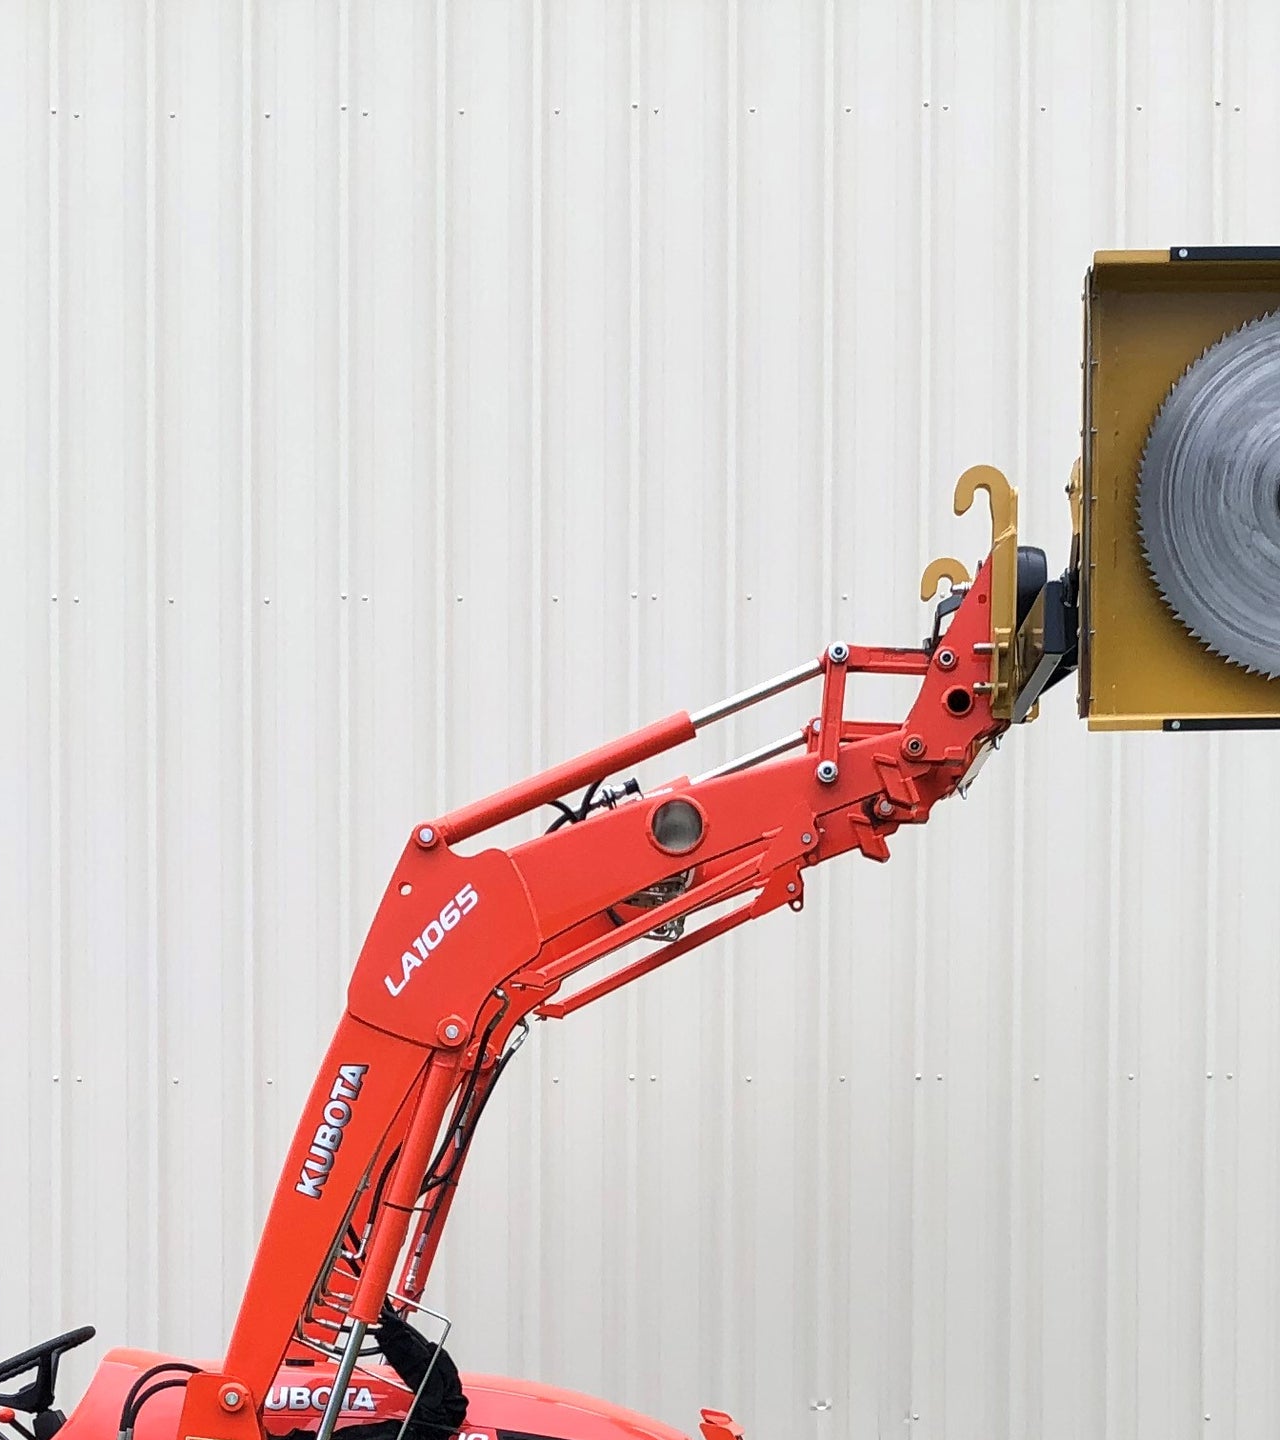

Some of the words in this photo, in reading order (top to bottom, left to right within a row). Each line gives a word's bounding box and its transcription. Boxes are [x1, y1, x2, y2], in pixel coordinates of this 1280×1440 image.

[384, 883, 479, 997] LA1065
[295, 1064, 369, 1199] KUBOTA
[264, 1386, 377, 1411] UBOTA
